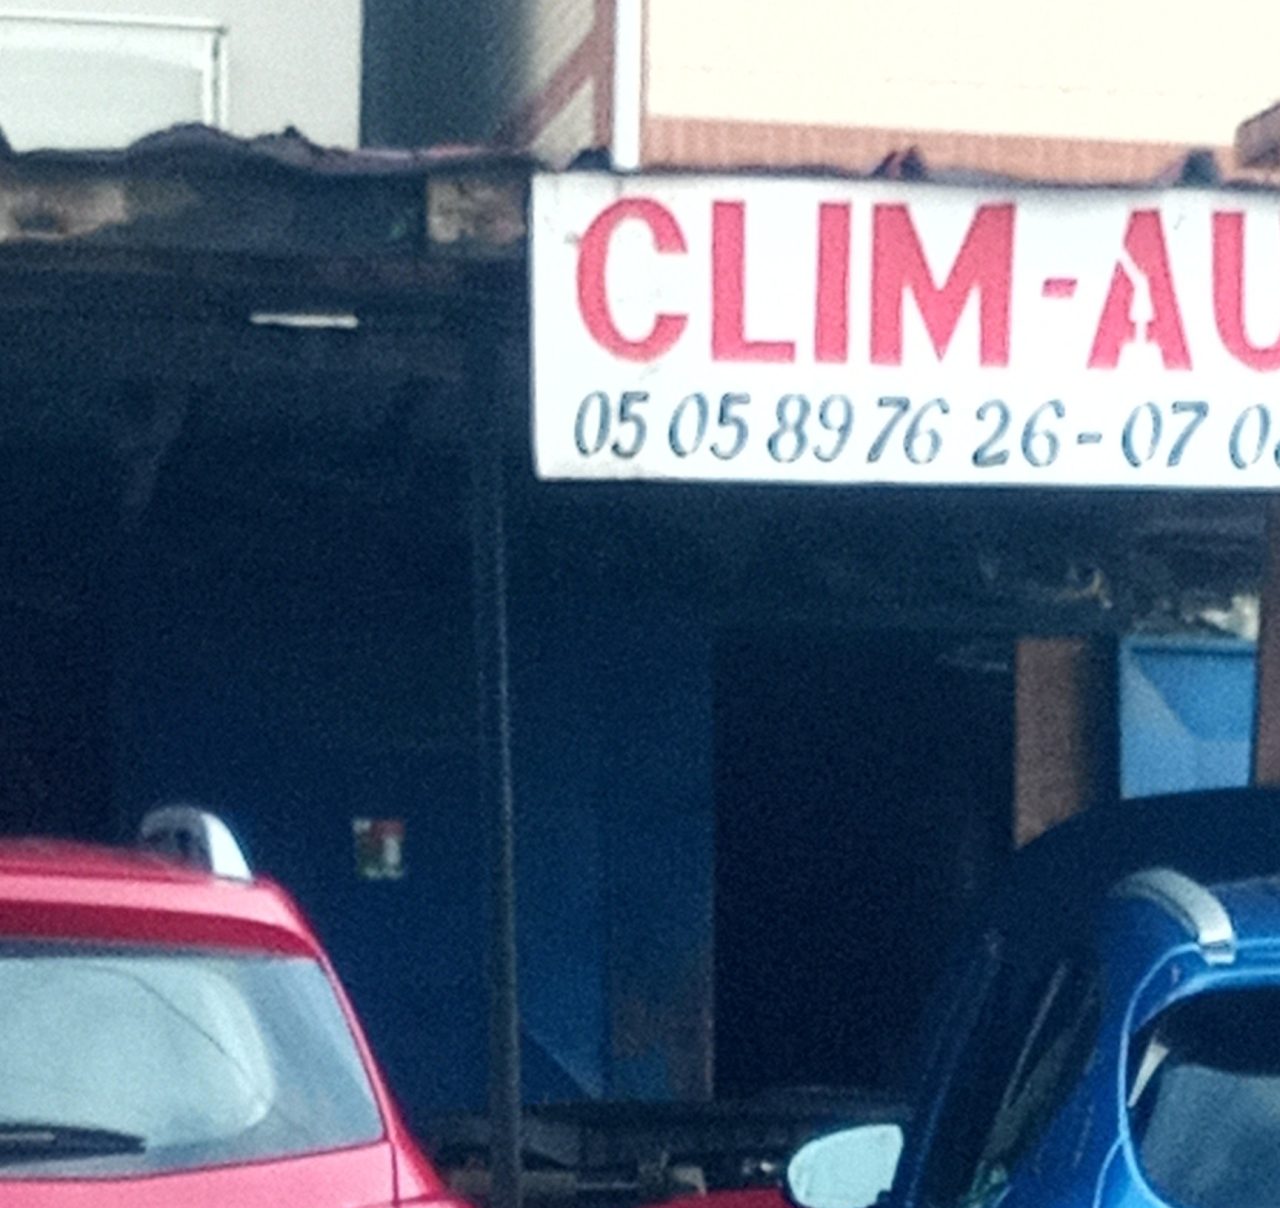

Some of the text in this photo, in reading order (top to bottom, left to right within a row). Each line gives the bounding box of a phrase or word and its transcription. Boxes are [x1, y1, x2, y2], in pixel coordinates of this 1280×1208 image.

[573, 391, 650, 459] 05
[668, 391, 751, 461] 05
[766, 394, 854, 463] 89
[866, 397, 950, 465] 76
